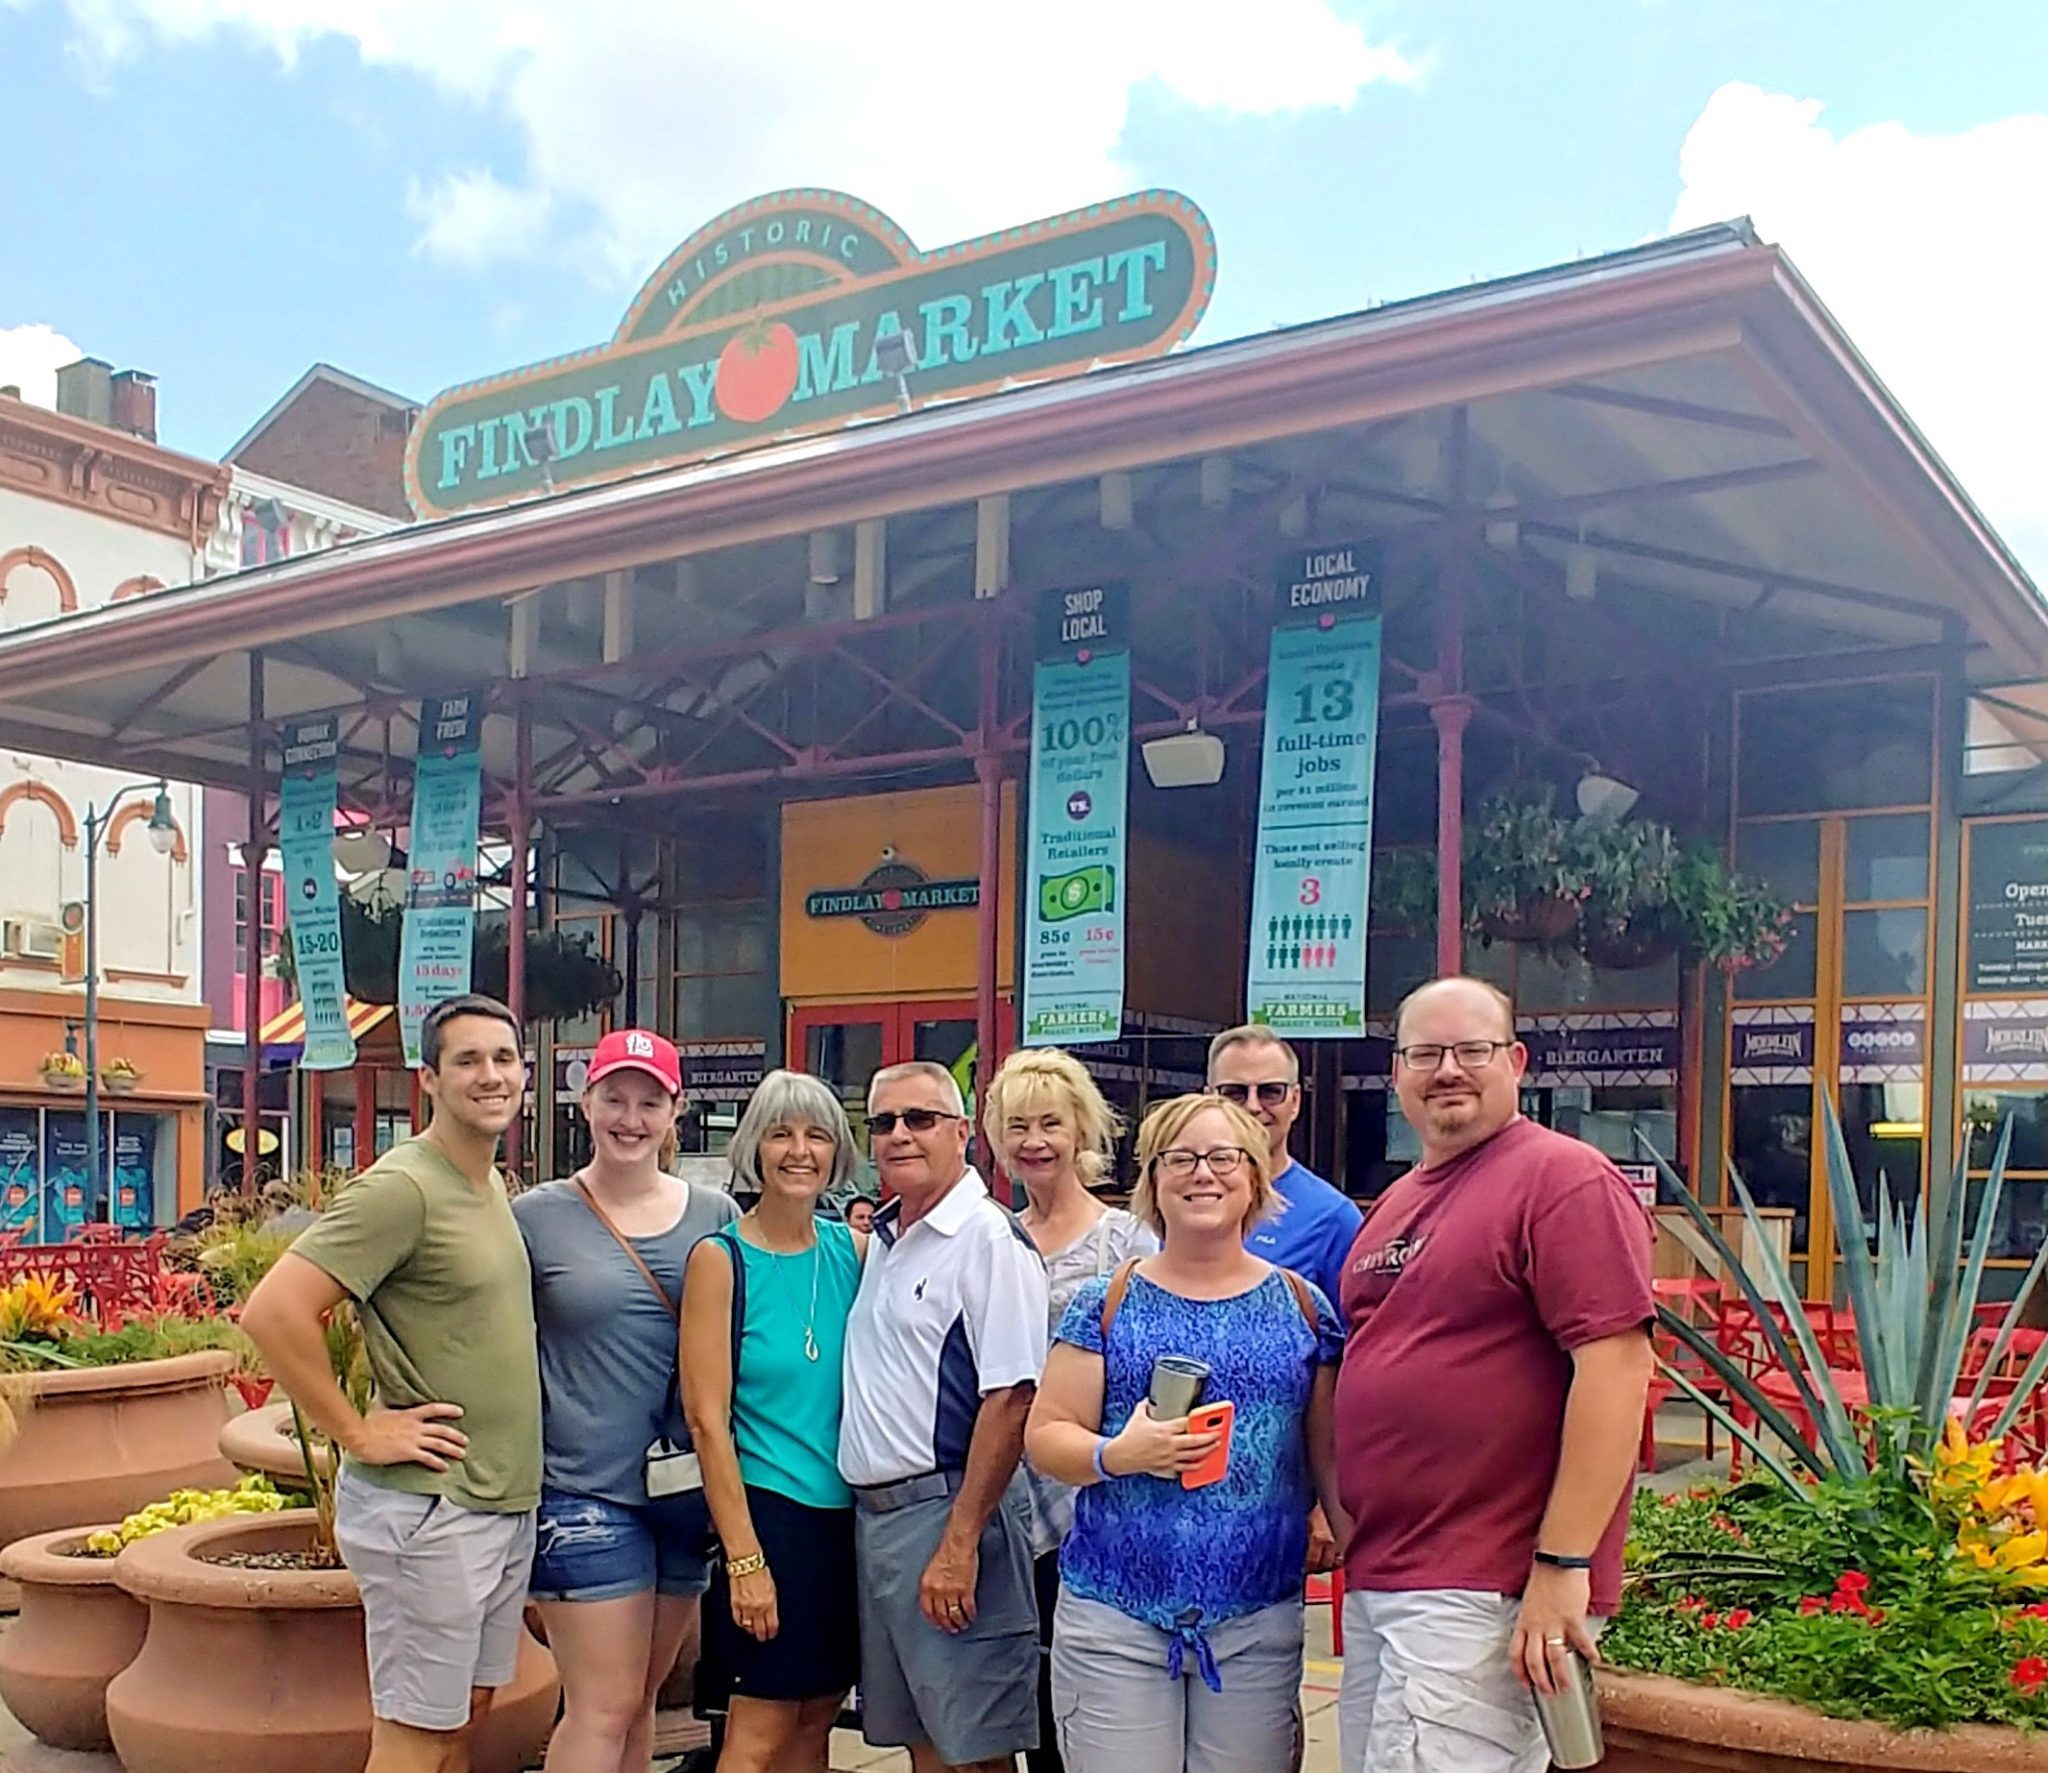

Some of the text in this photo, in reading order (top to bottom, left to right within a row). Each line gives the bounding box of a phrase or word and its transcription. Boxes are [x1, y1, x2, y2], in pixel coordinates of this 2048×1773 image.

[669, 220, 858, 305] HISTORIC
[437, 240, 1167, 489] FINDLAY MARKET
[1306, 551, 1358, 578] LOCAL
[1065, 589, 1102, 615] SHOP
[1291, 574, 1370, 607] ECONOMY
[1062, 614, 1107, 641] LOCAL
[1293, 680, 1354, 725] 13
[1041, 712, 1125, 752] 100%
[1276, 731, 1366, 753] full-time
[1294, 755, 1341, 779] jobs
[1041, 826, 1116, 845] Traditional
[1048, 845, 1110, 860] Retailers
[1314, 857, 1353, 867] create
[810, 886, 979, 914] FINDLAY MARKET
[1300, 878, 1320, 905] 3
[2005, 883, 2048, 902] Open
[299, 931, 338, 954] 15-20
[1040, 929, 1071, 945] 85¢
[1039, 1010, 1107, 1026] FARMERS
[1265, 1004, 1347, 1017] FARMERS
[1545, 1047, 1663, 1066] BIERGARTEN
